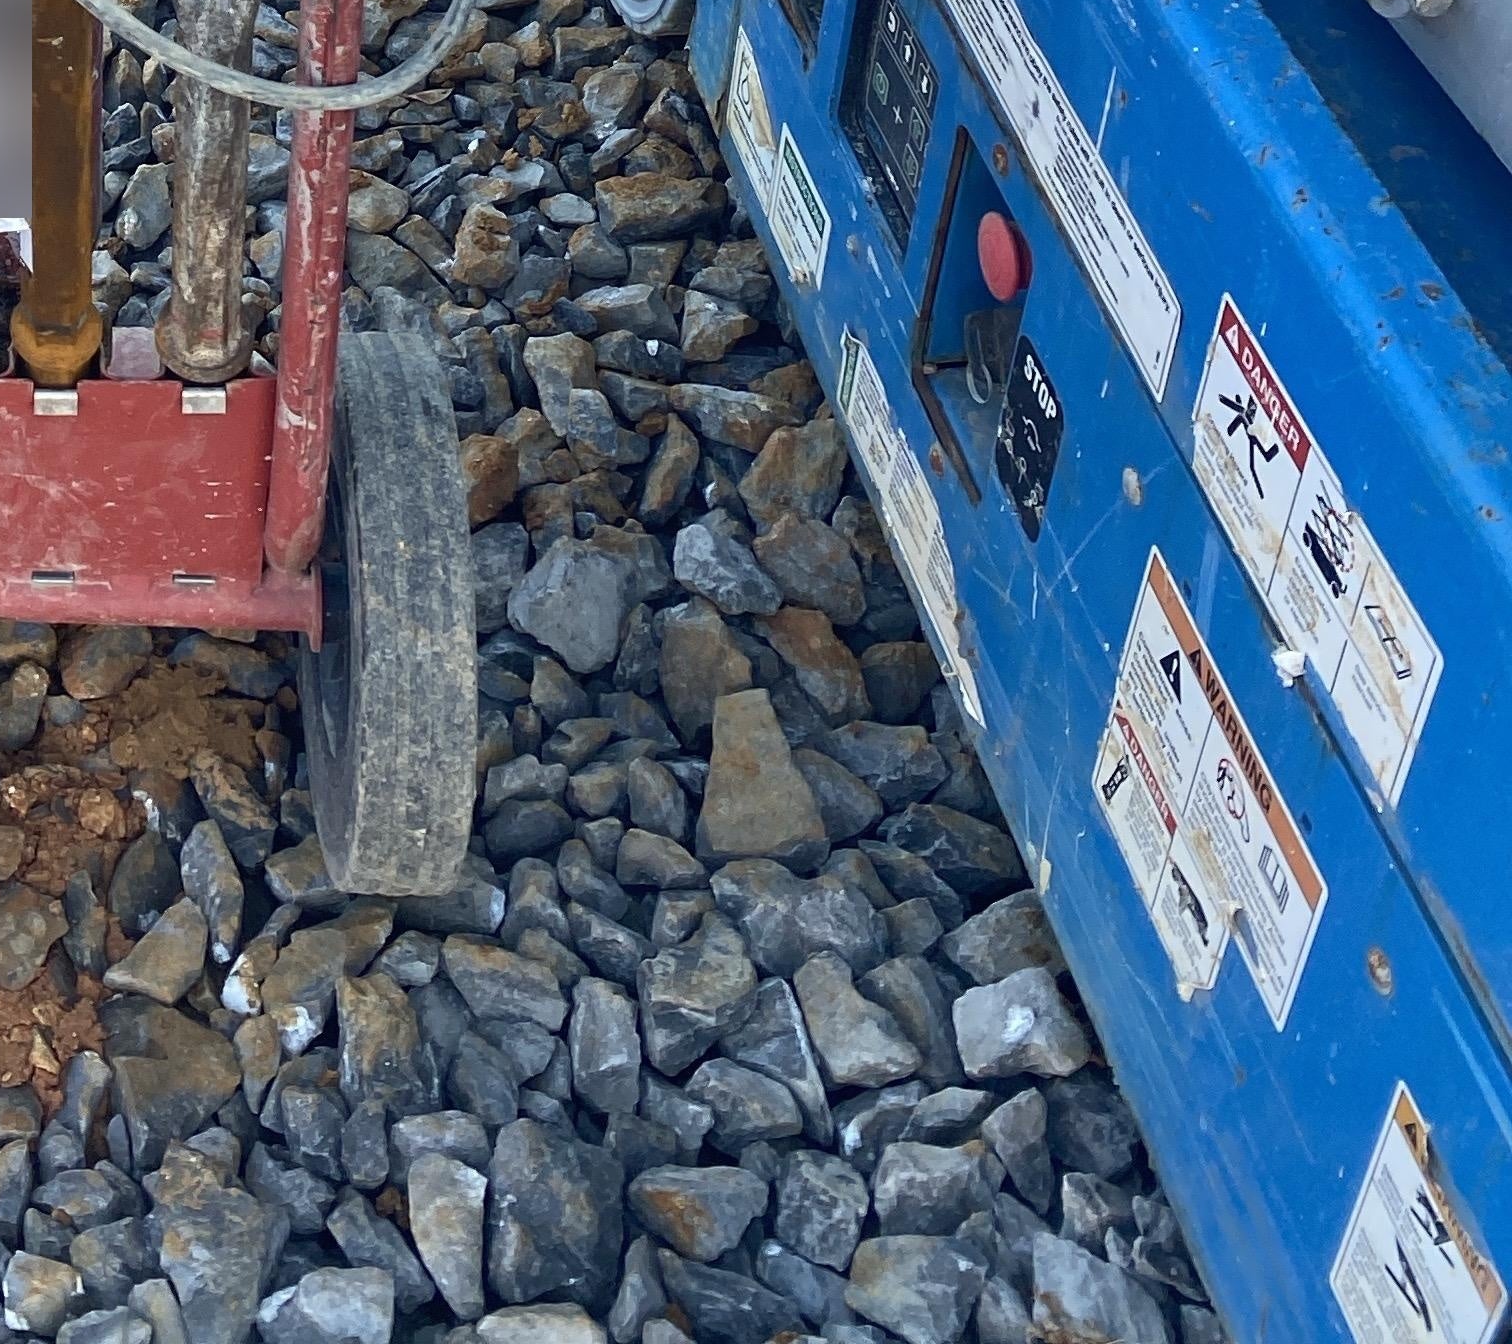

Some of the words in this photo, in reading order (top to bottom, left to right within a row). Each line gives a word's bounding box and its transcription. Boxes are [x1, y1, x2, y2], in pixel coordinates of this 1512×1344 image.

[1024, 354, 1057, 420] STOP
[1241, 346, 1300, 452] DANGER
[1129, 736, 1169, 821] DANGER
[1204, 664, 1272, 812] WARNING
